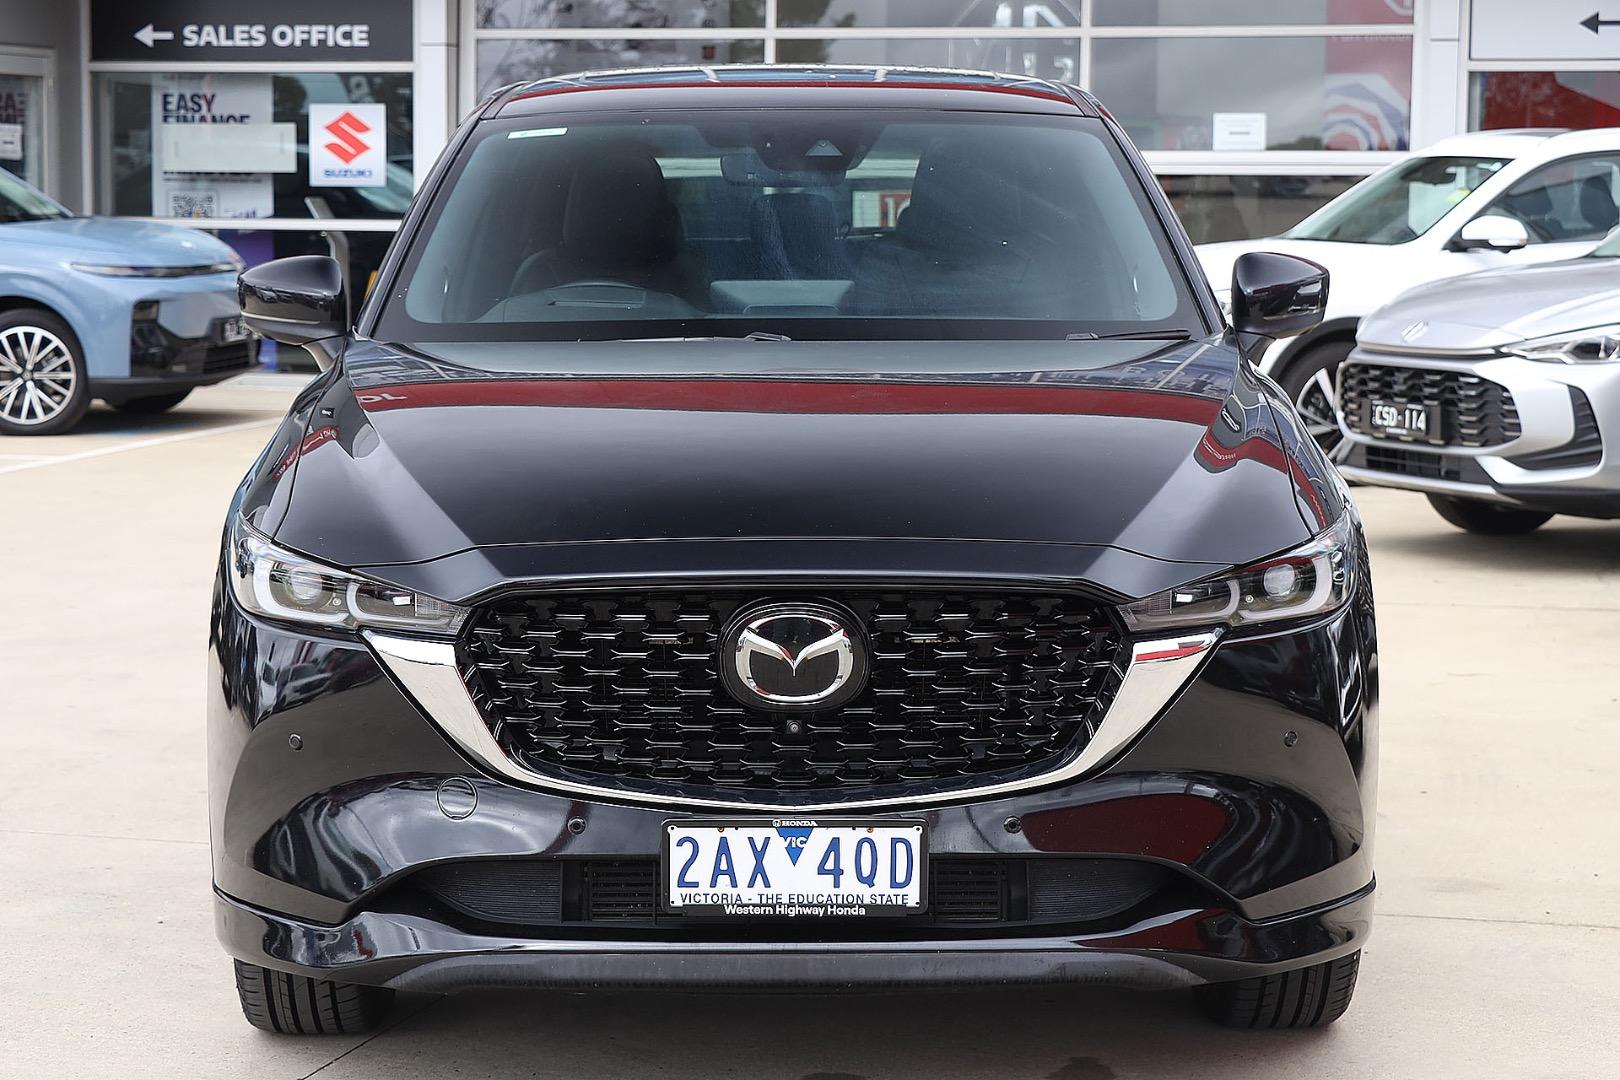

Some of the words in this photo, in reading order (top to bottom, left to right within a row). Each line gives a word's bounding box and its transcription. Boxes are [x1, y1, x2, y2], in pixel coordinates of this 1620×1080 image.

[182, 24, 267, 48] SALES
[271, 24, 370, 48] OFFICE
[162, 93, 216, 113] EASY
[676, 836, 771, 889] 2AX
[817, 836, 914, 889] 4QD
[680, 892, 743, 905] VICTORIA
[757, 893, 783, 905] THE
[788, 893, 864, 905] EDUCATION
[869, 893, 909, 905] STATE
[723, 904, 774, 915] Western
[775, 904, 825, 917] Highway
[827, 905, 866, 915] Honda
